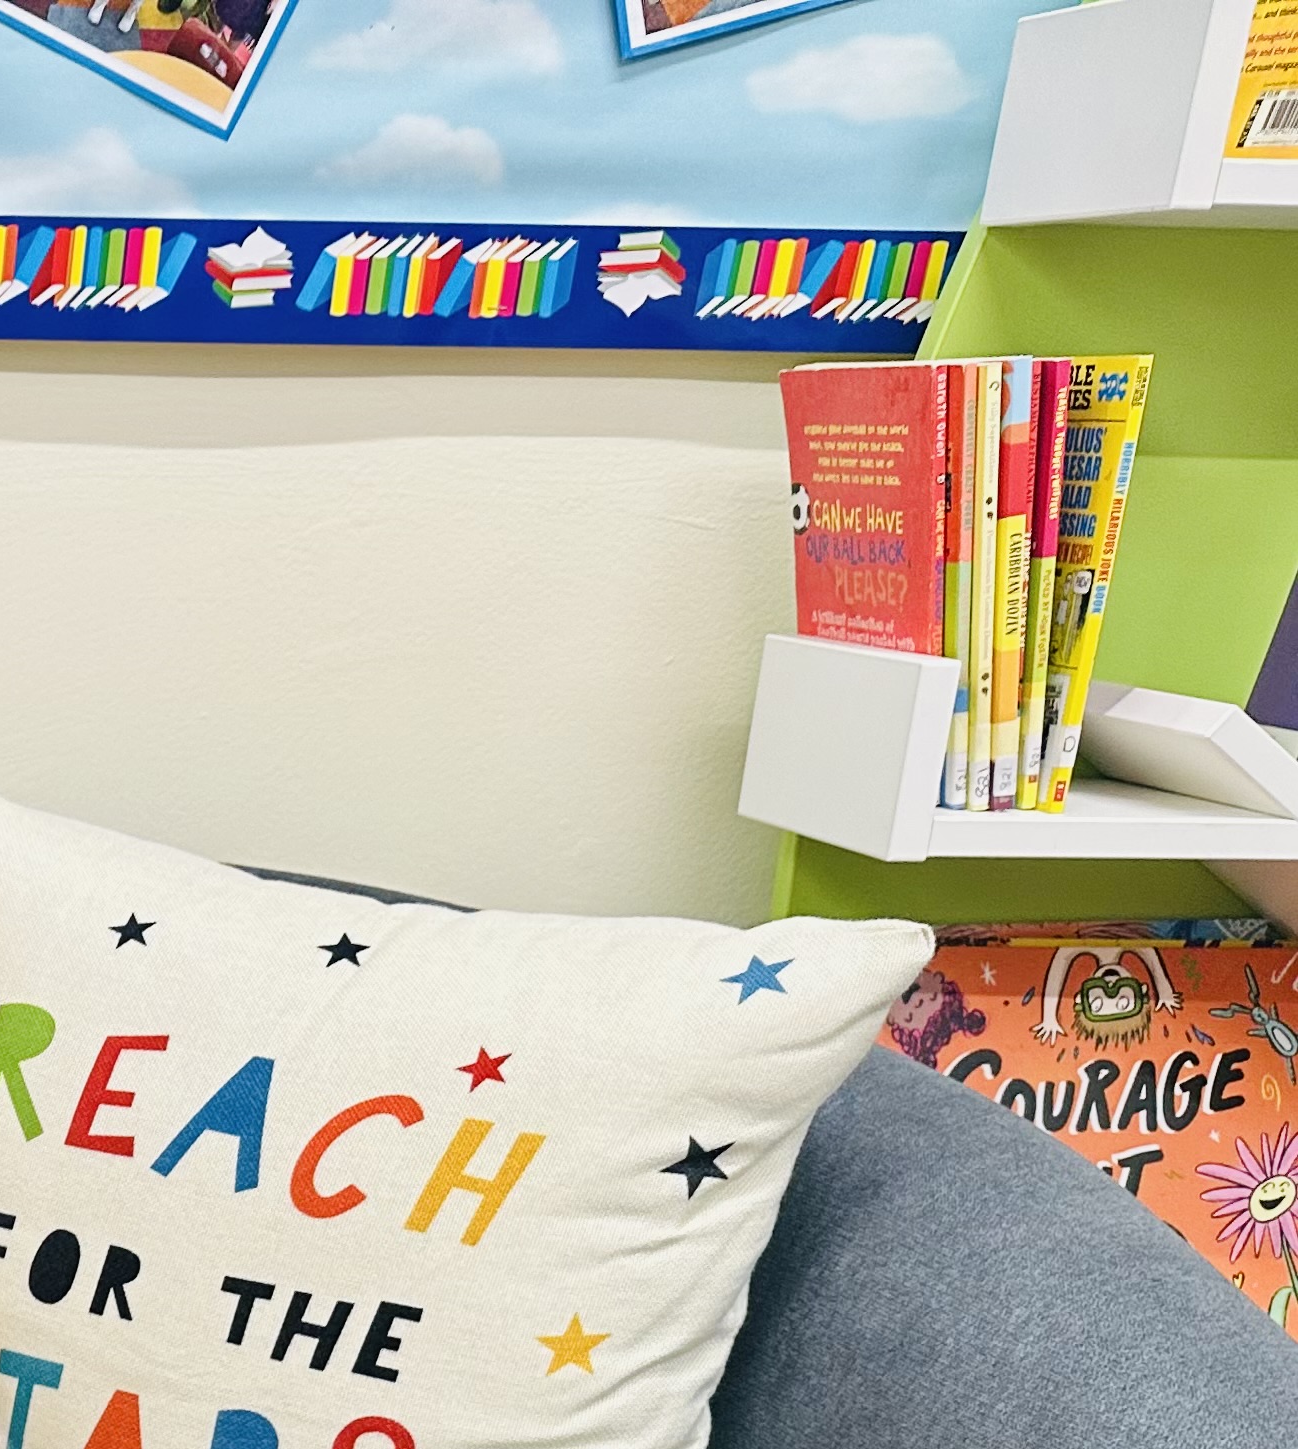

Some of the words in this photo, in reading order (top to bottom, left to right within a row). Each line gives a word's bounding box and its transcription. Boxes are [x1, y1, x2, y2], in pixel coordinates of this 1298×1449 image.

[1116, 442, 1135, 495] HORRIBLY
[813, 498, 841, 533] CAN
[842, 506, 863, 533] WE
[866, 503, 904, 535] HAVE
[806, 534, 829, 564] OUR
[833, 536, 865, 566] BALL
[1097, 559, 1112, 582] JOKE
[835, 565, 908, 613] PLEASE?
[221, 1275, 424, 1383] THE
